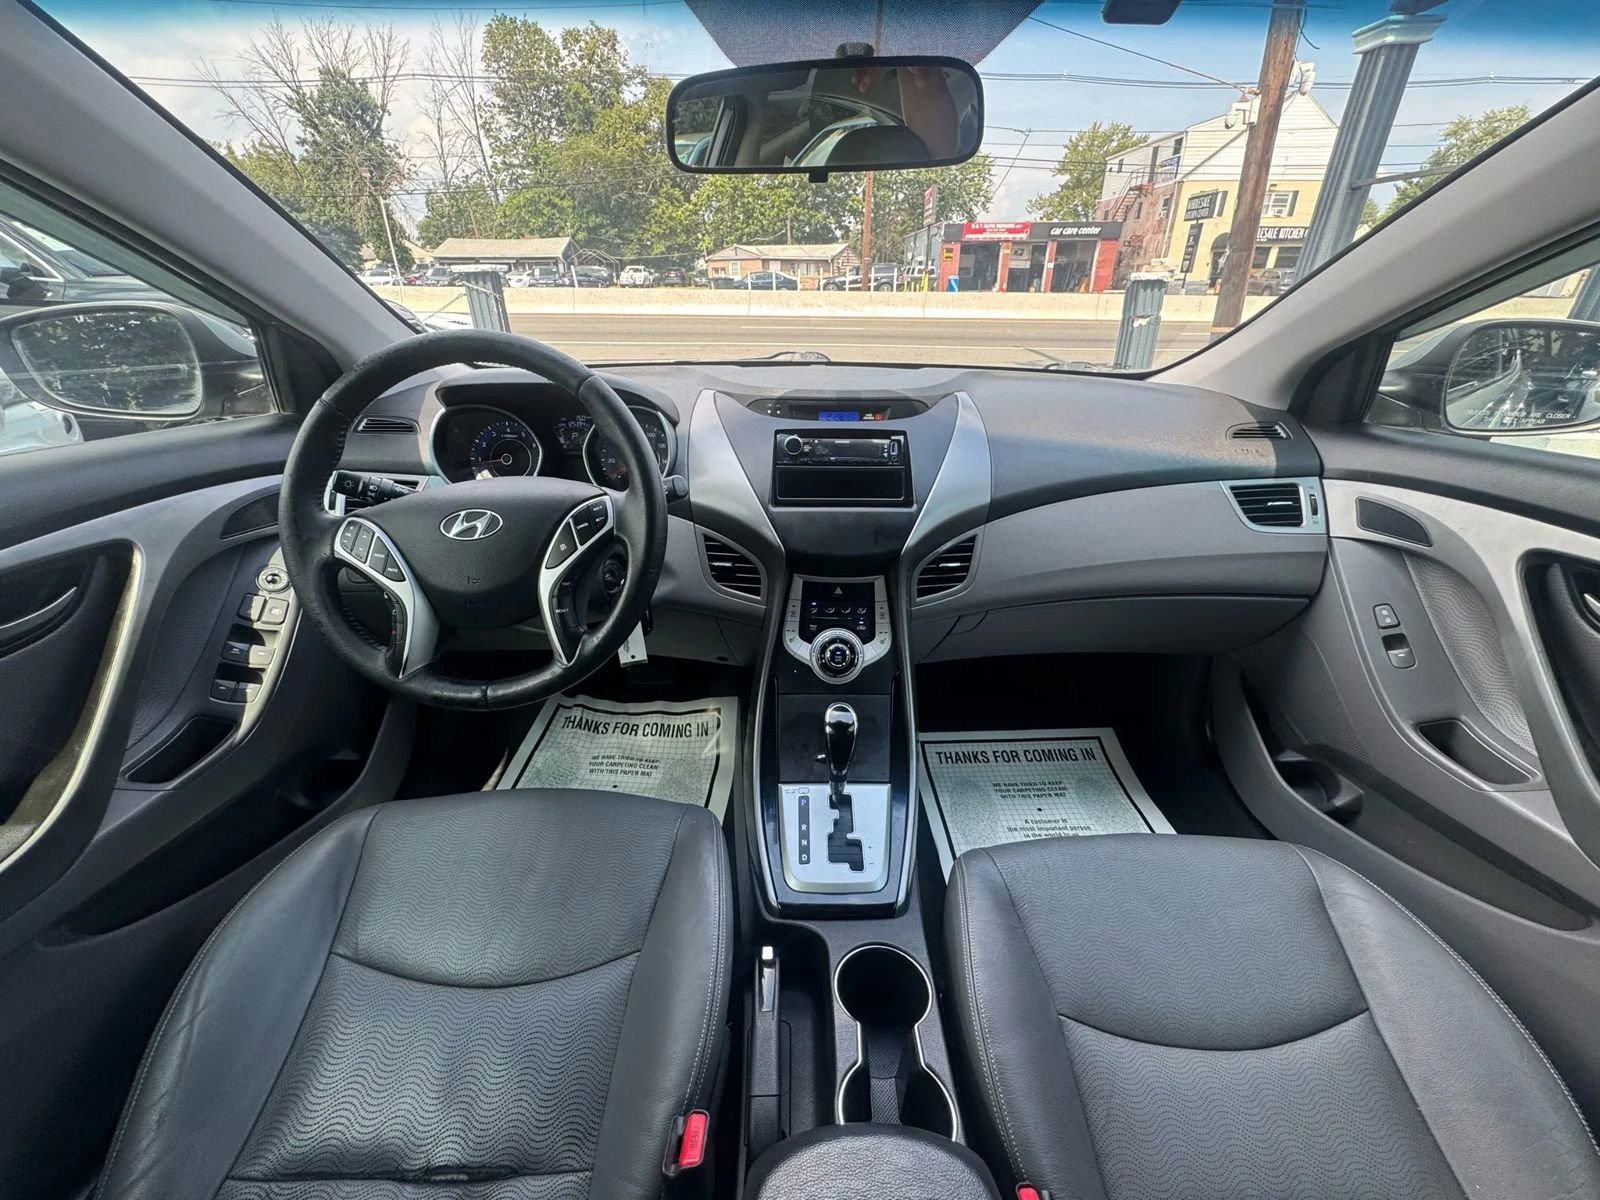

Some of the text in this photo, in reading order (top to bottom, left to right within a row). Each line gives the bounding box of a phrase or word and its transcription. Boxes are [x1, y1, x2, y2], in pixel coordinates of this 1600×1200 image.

[1051, 225, 1102, 235] car care center
[1256, 227, 1279, 239] LESALE
[1279, 227, 1305, 239] KITCHEN
[561, 715, 709, 738] THANKS FOR COMING IN
[935, 747, 1097, 765] THANKS FOR COMING IN
[605, 761, 638, 769] CARPETING
[1037, 825, 1068, 833] important
[1069, 825, 1092, 833] person
